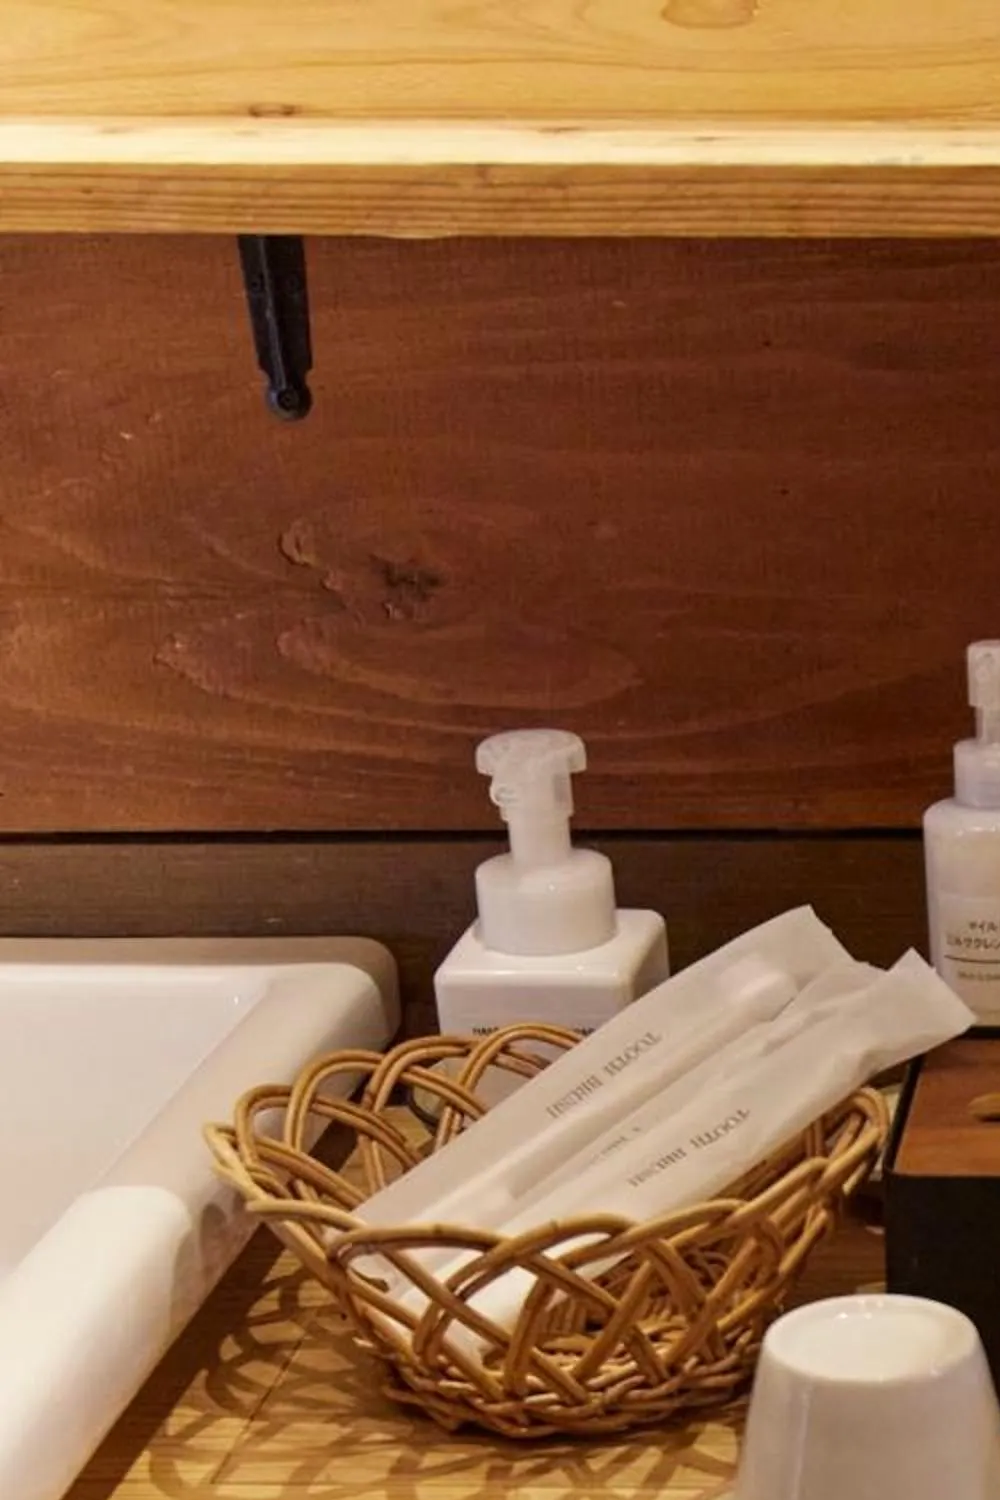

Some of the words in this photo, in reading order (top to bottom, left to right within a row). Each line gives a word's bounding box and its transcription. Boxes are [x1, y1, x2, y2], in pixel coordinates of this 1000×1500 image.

[603, 1031, 663, 1077] TOOTH
[545, 1074, 604, 1119] BRUSH
[689, 1109, 750, 1149] TOOTH
